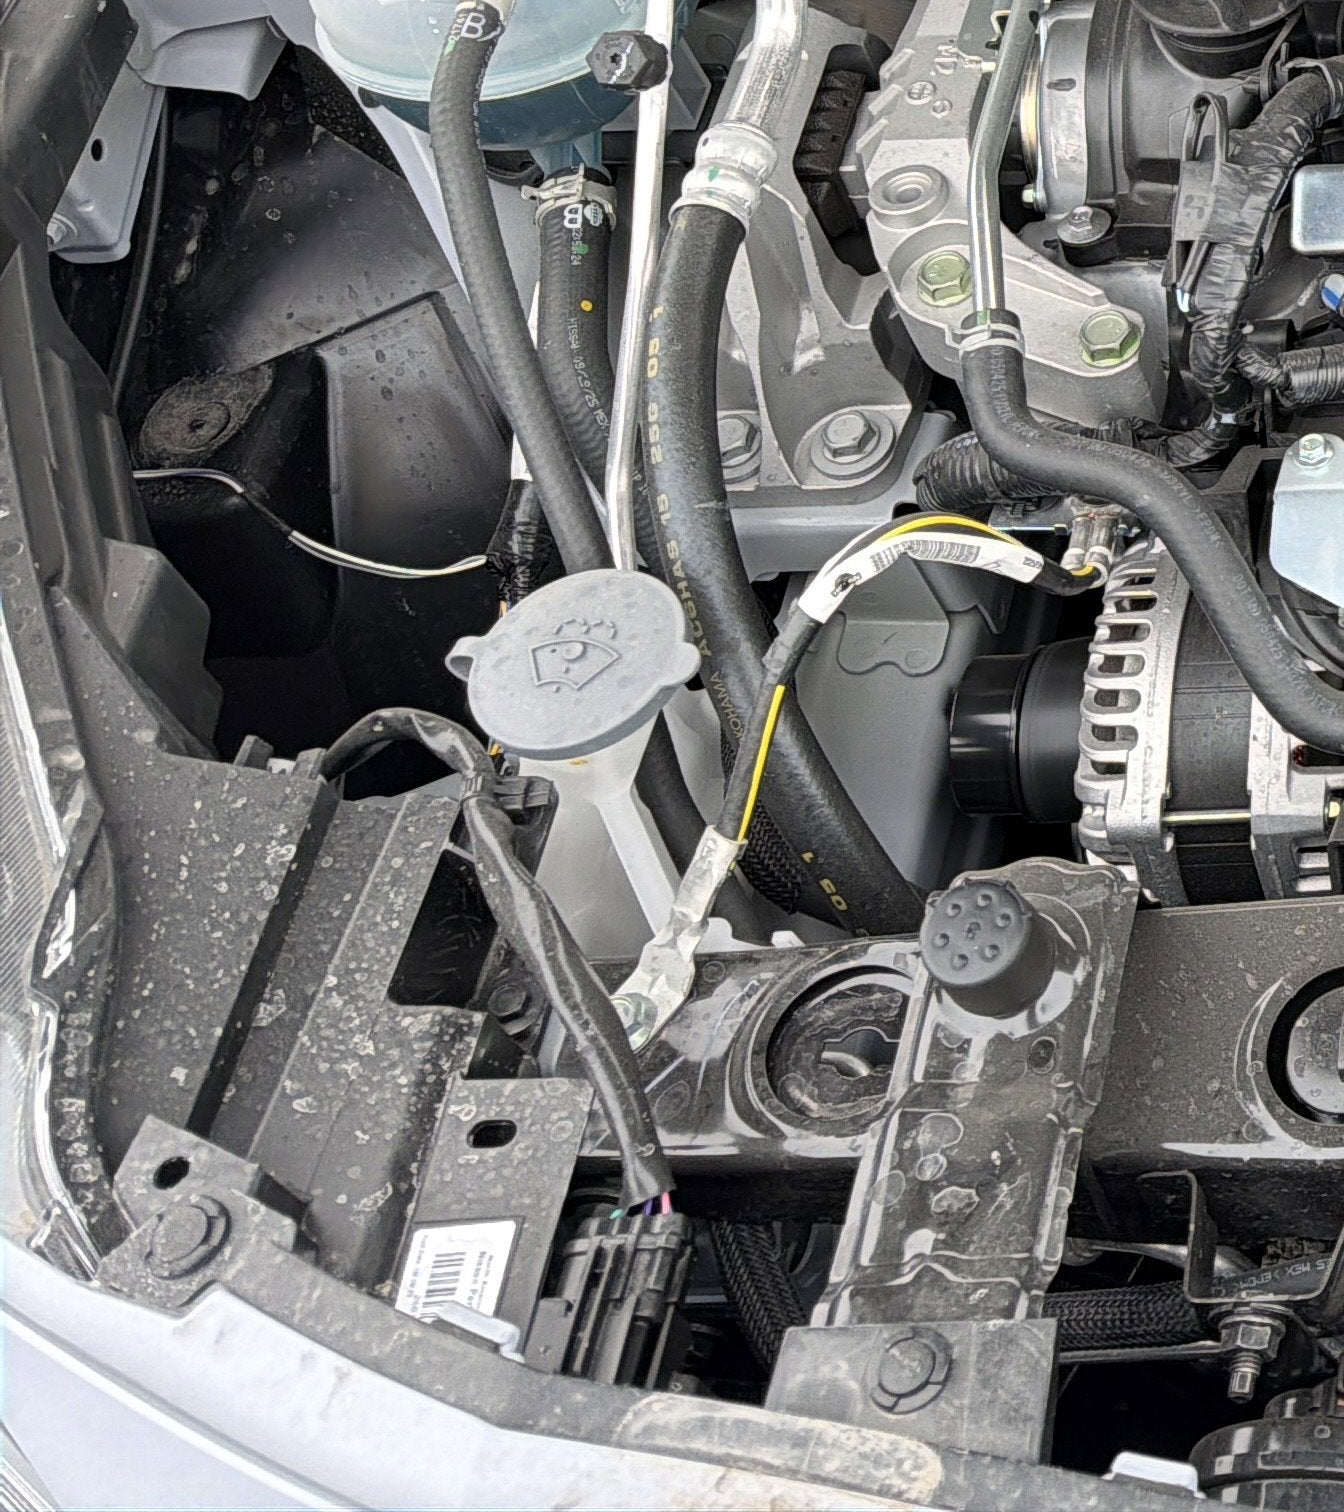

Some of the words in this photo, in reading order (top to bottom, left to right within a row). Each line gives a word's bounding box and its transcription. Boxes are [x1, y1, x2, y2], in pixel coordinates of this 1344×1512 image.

[460, 11, 487, 40] B
[563, 203, 584, 229] B
[656, 492, 672, 527] 15
